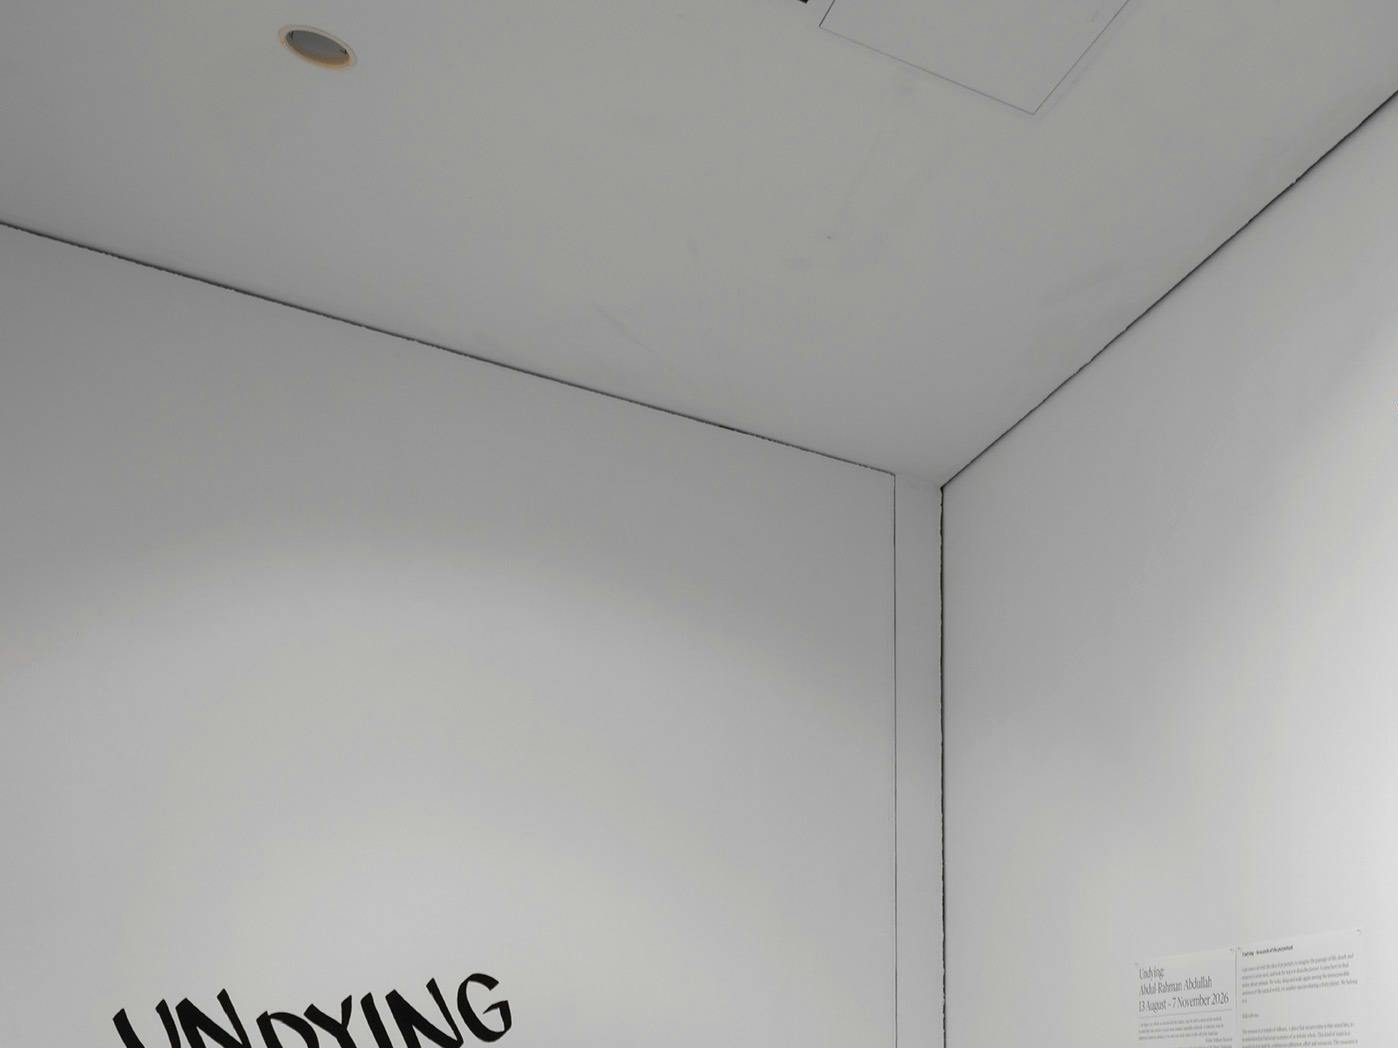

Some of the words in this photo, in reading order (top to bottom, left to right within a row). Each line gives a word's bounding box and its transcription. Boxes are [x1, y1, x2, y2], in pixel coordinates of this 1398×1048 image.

[1184, 976, 1213, 990] Abdullah
[1147, 1000, 1166, 1014] August
[1178, 994, 1211, 1008] November
